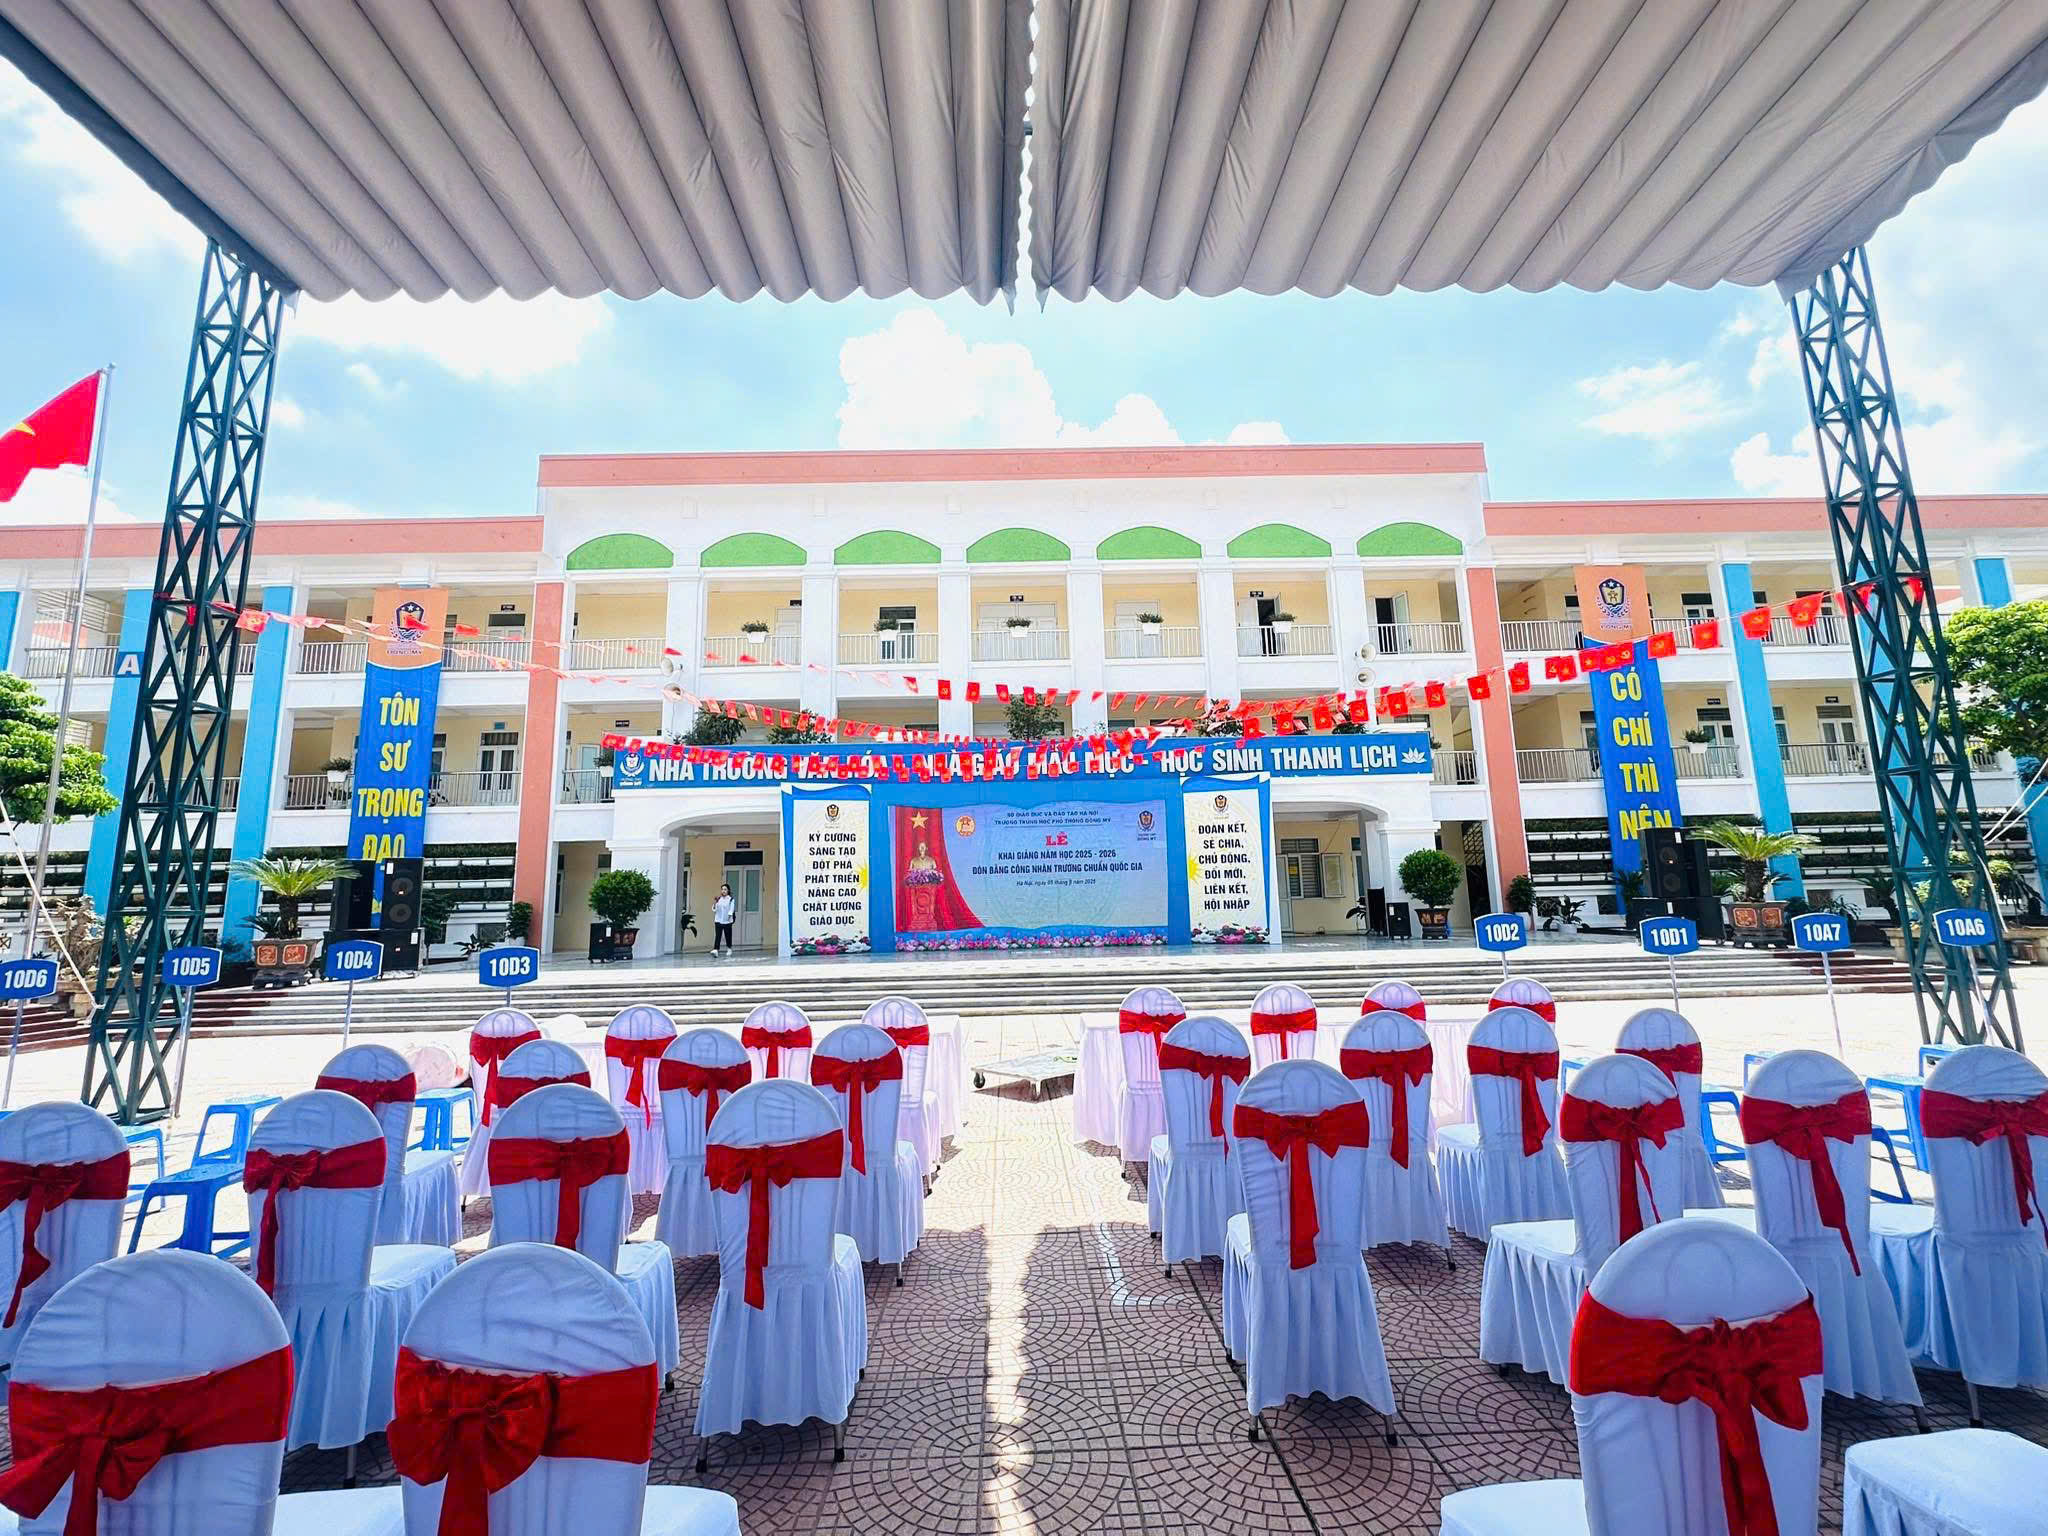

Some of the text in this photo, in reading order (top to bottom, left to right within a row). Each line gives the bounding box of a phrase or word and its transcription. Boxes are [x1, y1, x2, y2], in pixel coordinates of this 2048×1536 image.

[117, 653, 140, 675] A
[1610, 667, 1642, 701] CÓ
[379, 692, 420, 727] TÔN
[1613, 713, 1652, 747] CHÍ
[379, 739, 412, 772] SƯ
[971, 748, 1021, 776] GÁO
[1161, 749, 1203, 777] HỌC
[1212, 748, 1264, 772] SINH
[1270, 746, 1343, 771] THANH
[1350, 745, 1397, 772] LỊCH
[1619, 757, 1660, 793] THÌ
[358, 788, 424, 824] TRỌNG
[1198, 822, 1225, 834] ĐOÀN
[1619, 803, 1673, 840] NÊN
[824, 832, 857, 842] CƯƠNG
[809, 845, 856, 858] SÁNG TẠO
[998, 851, 1015, 860] KHAI
[1016, 849, 1039, 859] GIẢNG
[1059, 850, 1073, 860] HỌC
[1075, 849, 1093, 858] 2025
[1099, 849, 1117, 858] 2026
[1198, 852, 1218, 864] CHỦ
[812, 859, 853, 871] ĐỘT PHÁ
[1010, 864, 1031, 874] CÔNG
[1130, 862, 1143, 871] GIA
[804, 871, 860, 884] PHÁT TRIỂN
[808, 886, 857, 898] NÂNG CAO
[1204, 883, 1226, 895] LIÊN
[830, 901, 862, 913] LƯỢNG
[1204, 898, 1250, 912] HỘI NHẬP
[809, 914, 855, 927] GIÁO DỤC
[1945, 918, 1985, 937] 10A6
[1484, 923, 1520, 942] 10D2
[1650, 927, 1688, 947] 10D1
[1803, 923, 1841, 942] 10A7
[172, 957, 211, 976] 10D5
[336, 950, 373, 970] 10D4
[489, 956, 531, 977] 10D3
[4, 969, 48, 989] 10D6
